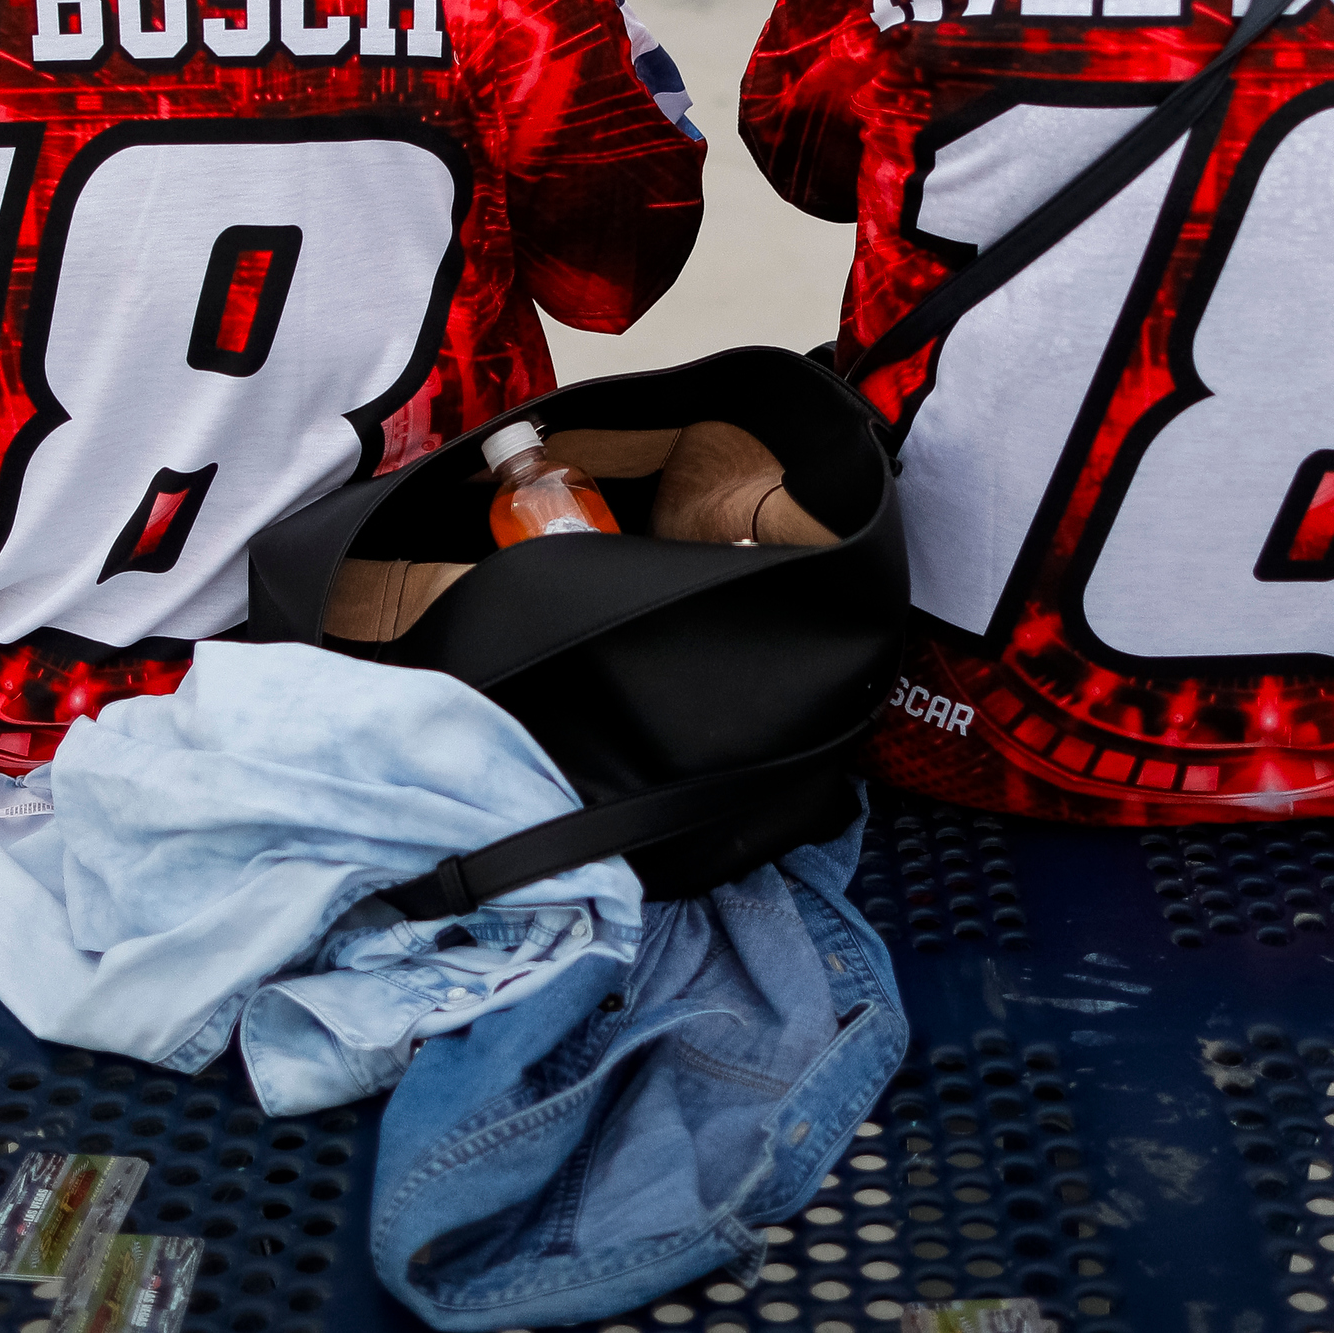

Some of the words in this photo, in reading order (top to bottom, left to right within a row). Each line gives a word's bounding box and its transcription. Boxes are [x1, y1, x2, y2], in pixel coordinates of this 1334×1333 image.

[888, 675, 976, 738] SCAR
[31, 1187, 49, 1211] VEGAS
[24, 1205, 40, 1223] LAS
